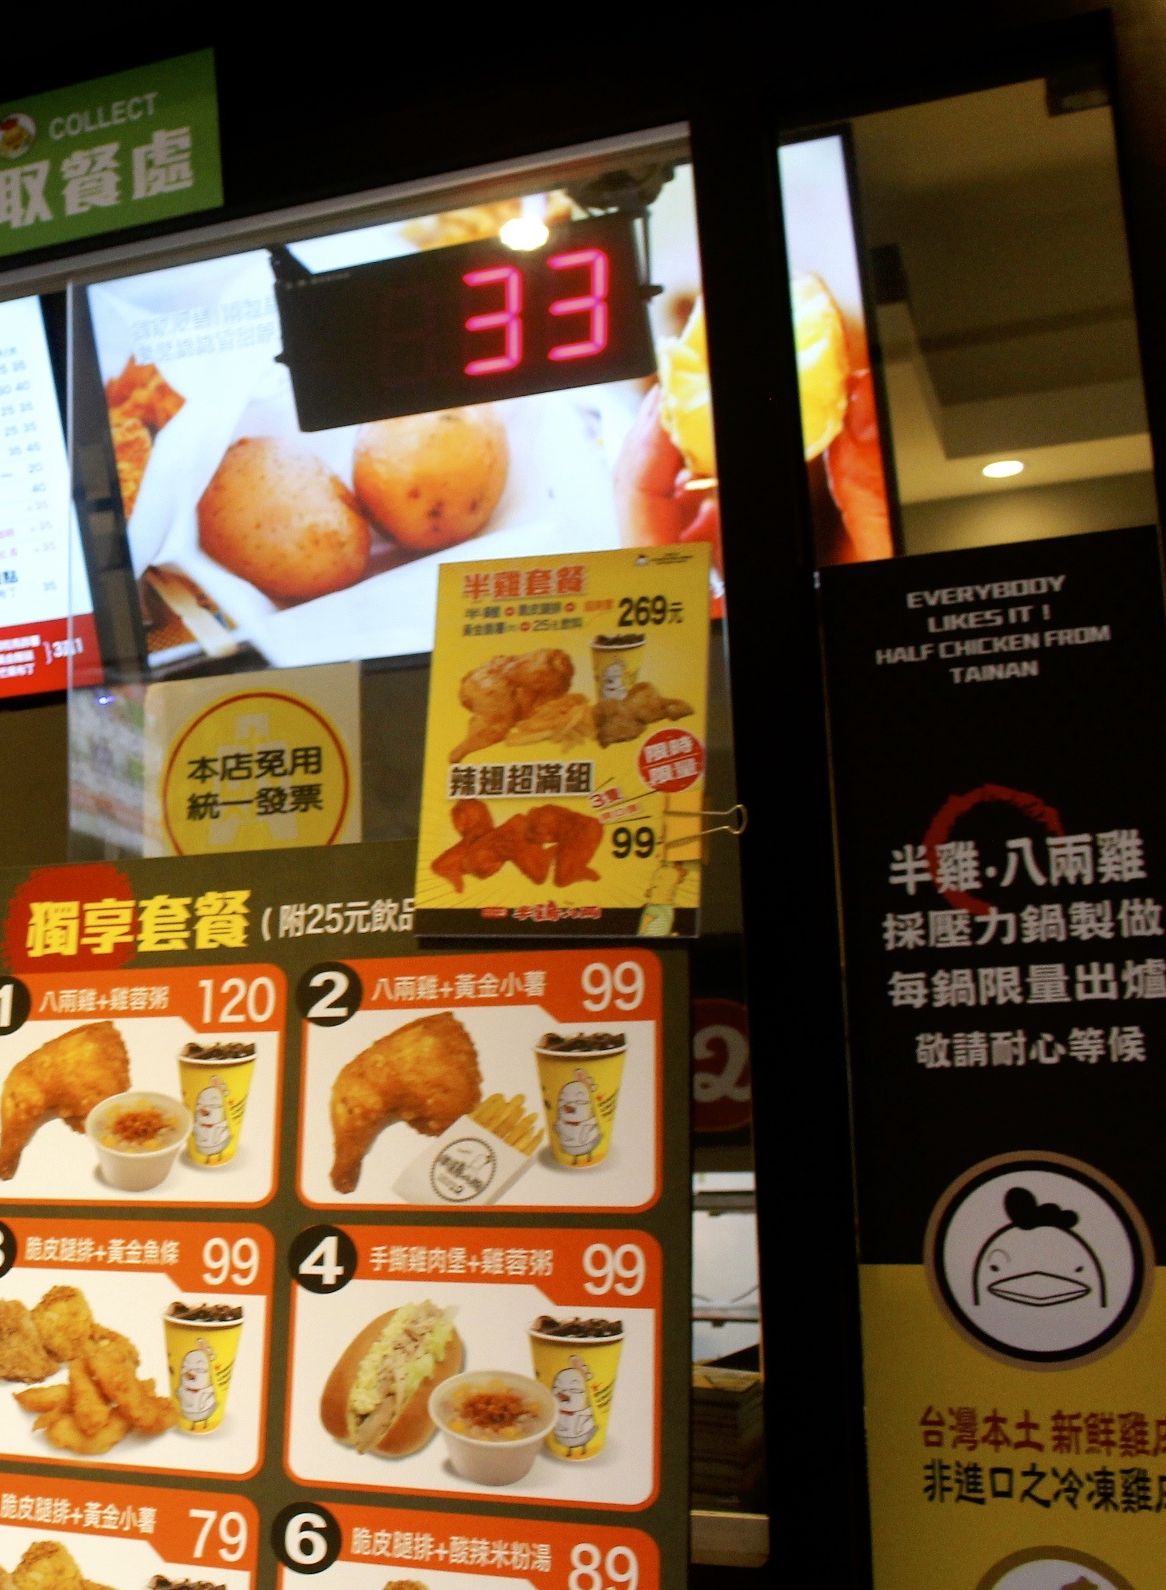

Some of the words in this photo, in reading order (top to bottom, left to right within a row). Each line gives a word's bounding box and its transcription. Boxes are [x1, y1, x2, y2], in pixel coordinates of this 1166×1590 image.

[49, 92, 158, 139] COLLECT
[462, 248, 608, 375] 33
[462, 565, 586, 601] 半雞套餐
[906, 575, 1067, 609] EVERYBODY
[927, 609, 1003, 633] LIKES
[1008, 605, 1034, 624] IT
[875, 643, 934, 665] HALF
[938, 631, 1041, 659] CHICKEN
[1044, 624, 1112, 648] FROM
[948, 660, 1039, 684] TAINAN
[187, 746, 322, 784] 本店免用
[449, 763, 593, 798] 辣翅超滿組
[187, 783, 323, 822] 統一發票
[612, 826, 655, 859] 99
[26, 889, 251, 957] 獨享套餐
[881, 897, 1165, 951] 採壓力鍋製做
[198, 976, 277, 1024] 120
[307, 971, 350, 1018] 2
[371, 972, 546, 1001] 八兩雞+黃金小薯
[581, 961, 645, 1012] 99
[887, 958, 1166, 1010] 每鍋限量出爐
[915, 1026, 1148, 1069] 敬請耐心等候
[202, 1237, 260, 1286] 99
[298, 1236, 345, 1285] 4
[582, 1243, 646, 1296] 99
[919, 1406, 1044, 1453] 台灣本土
[188, 1508, 248, 1562] 79
[284, 1512, 328, 1564] 6
[568, 1543, 639, 1590] 89
